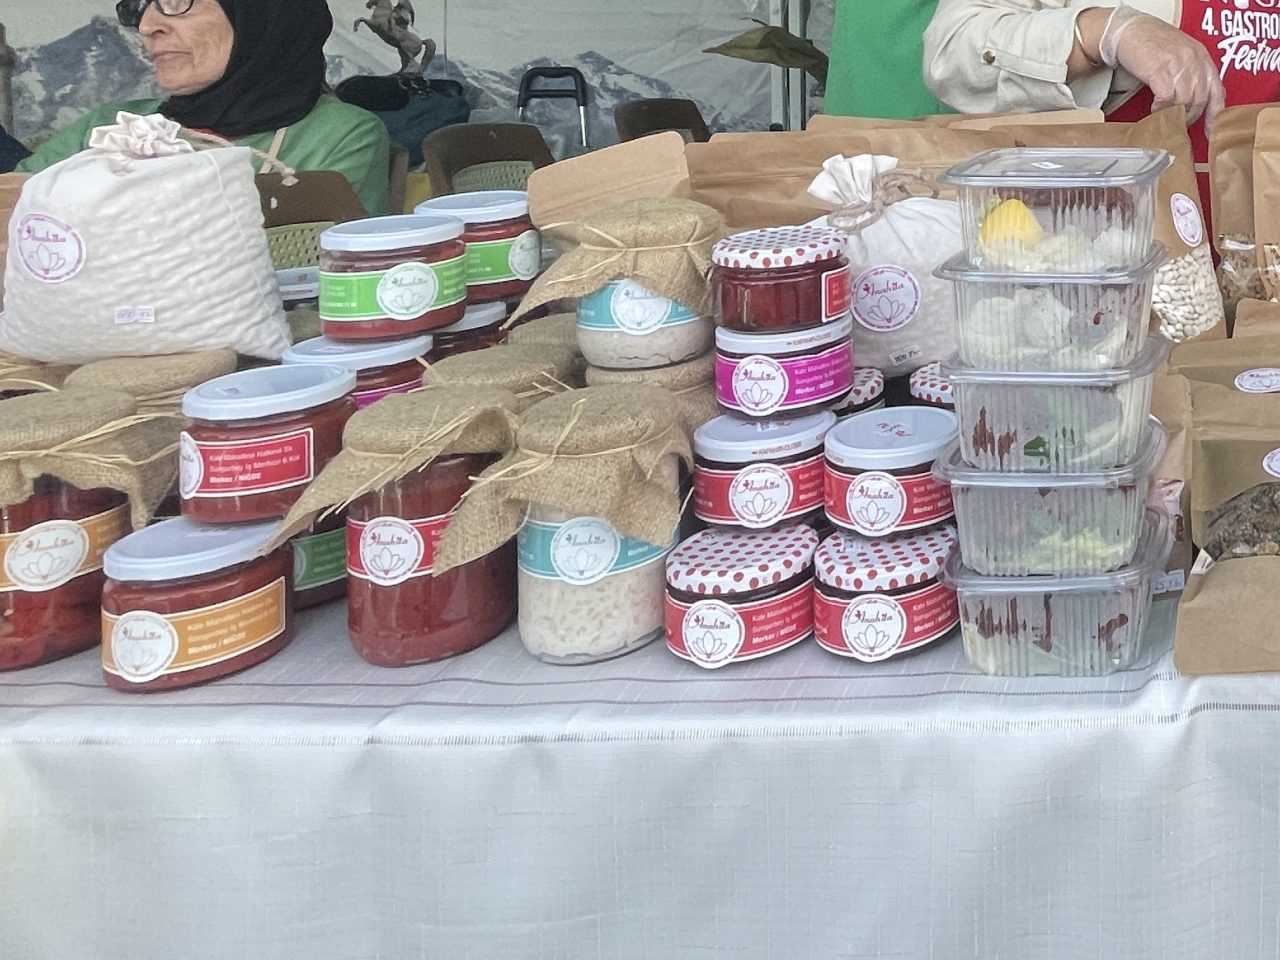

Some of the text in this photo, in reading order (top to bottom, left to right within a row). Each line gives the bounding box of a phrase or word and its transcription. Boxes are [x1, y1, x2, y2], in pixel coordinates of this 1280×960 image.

[1201, 7, 1219, 36] 4.
[859, 281, 904, 300] Anahita
[739, 368, 777, 383] Anahita
[739, 479, 780, 494] Anahita
[855, 485, 894, 501] Anahita
[689, 614, 731, 630] Anahita
[850, 609, 893, 625] Anahita
